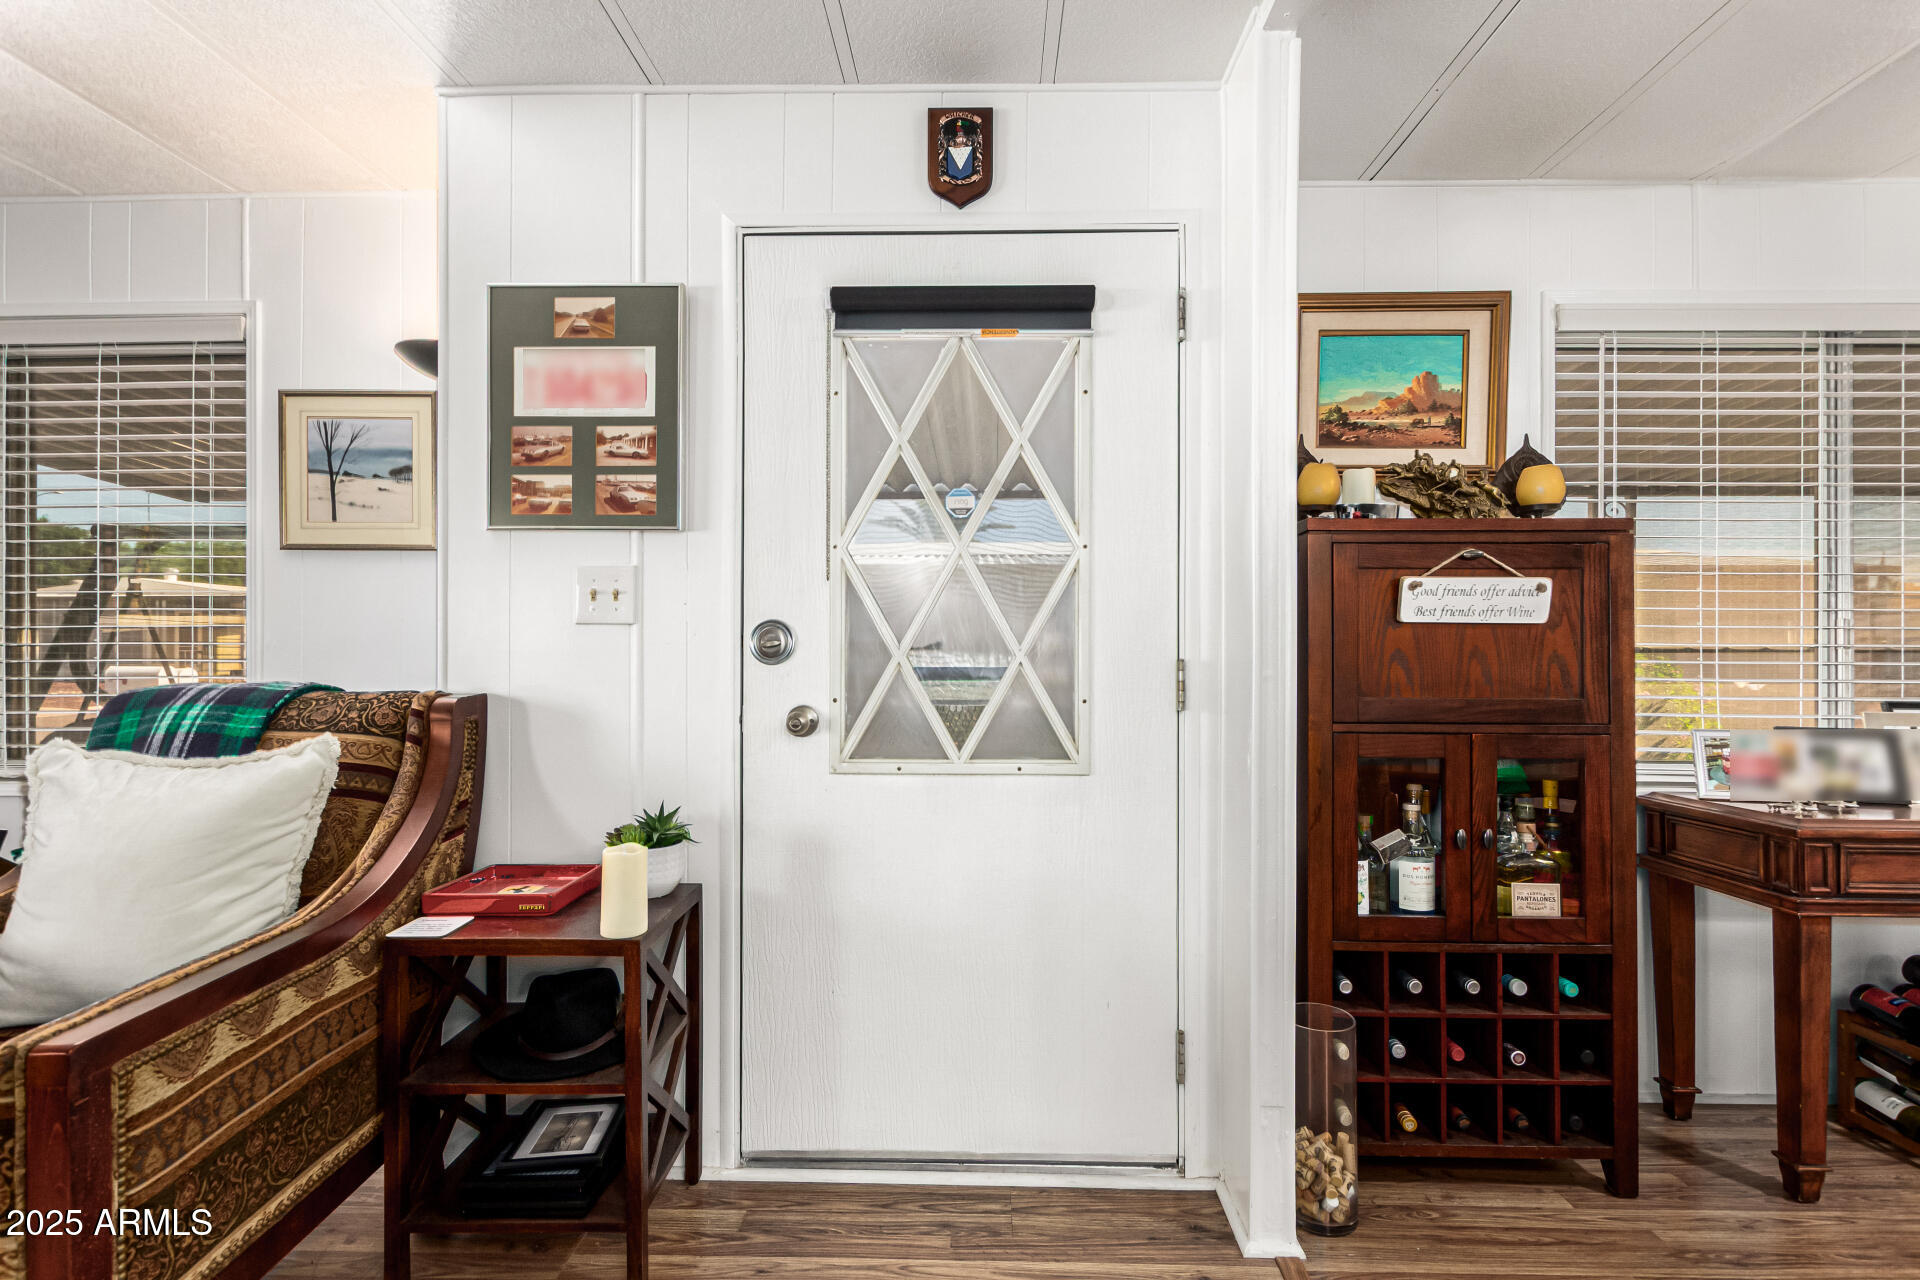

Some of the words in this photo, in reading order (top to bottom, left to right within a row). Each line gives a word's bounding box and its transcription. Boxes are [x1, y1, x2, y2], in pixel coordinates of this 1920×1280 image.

[1411, 583, 1442, 600] Good
[1438, 583, 1478, 601] friends
[1480, 583, 1506, 601] offer
[1414, 605, 1437, 617] Best
[1435, 604, 1476, 621] friends
[1478, 604, 1505, 621] offer
[1506, 604, 1536, 618] Wine
[1516, 895, 1556, 903] PANTALONES
